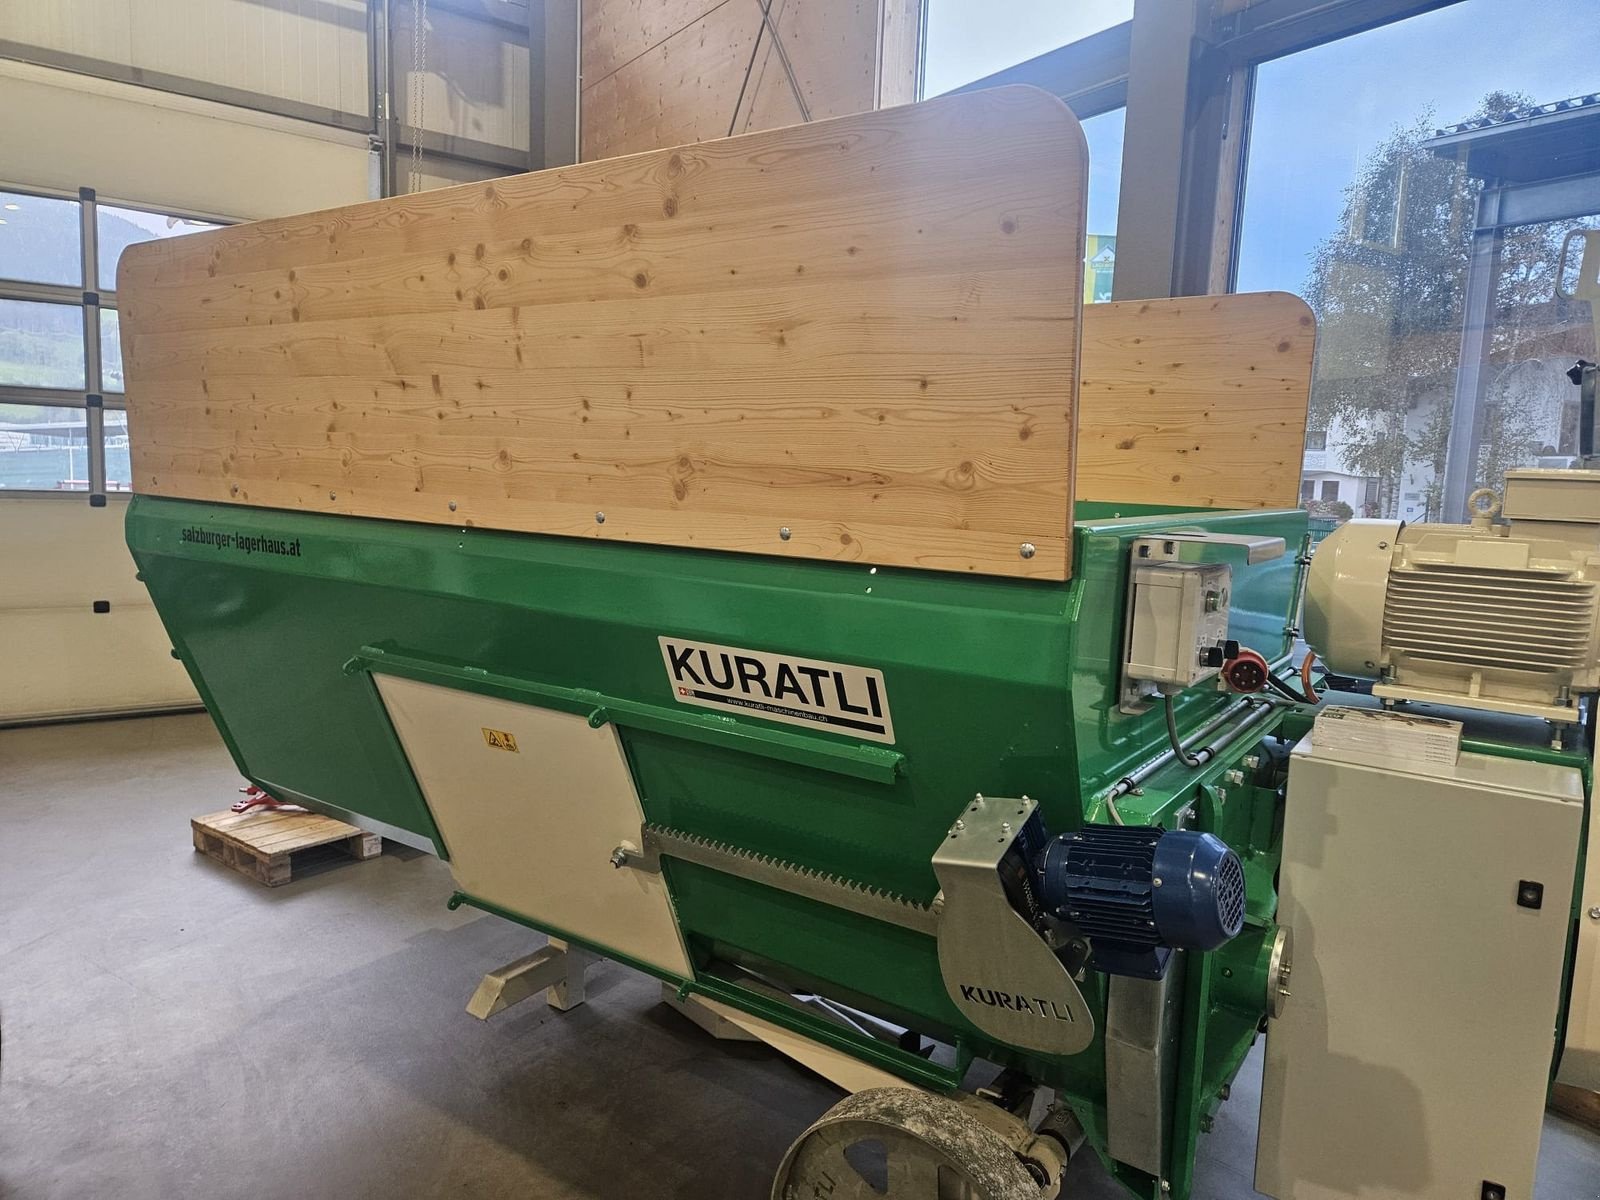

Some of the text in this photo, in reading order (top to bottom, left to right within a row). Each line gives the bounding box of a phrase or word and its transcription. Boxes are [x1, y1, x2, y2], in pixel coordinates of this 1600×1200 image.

[182, 526, 301, 557] salzburger-lagerhaus.at
[666, 644, 883, 718] KURATLI
[726, 698, 828, 723] www.kuratli-maschinenbau.ch
[960, 984, 1075, 1022] KURATLI
